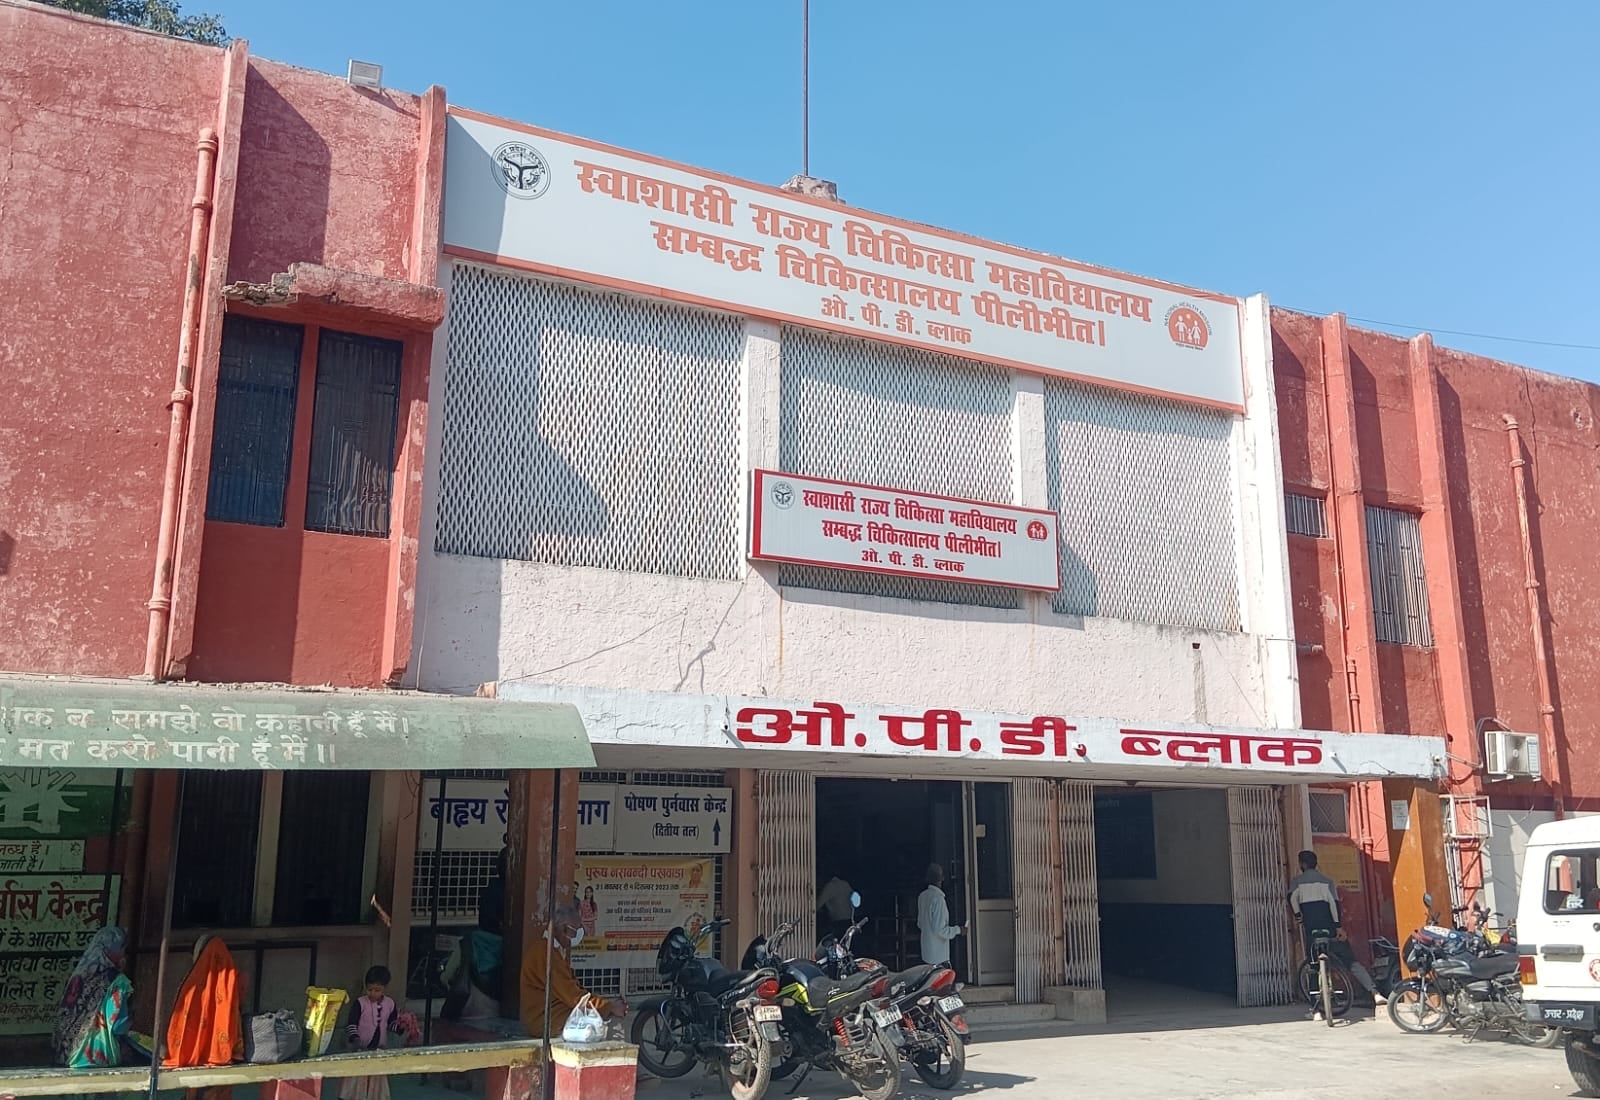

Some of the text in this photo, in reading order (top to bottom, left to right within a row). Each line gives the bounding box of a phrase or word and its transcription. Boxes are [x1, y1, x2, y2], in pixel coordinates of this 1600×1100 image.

[574, 160, 1152, 322] स्वाशासी राज्य चिकित्सा महाविद्यालय
[650, 221, 764, 272] सम्बद्ध
[775, 244, 962, 316] चिकित्सालय
[926, 320, 972, 344] ब्लाक
[803, 489, 856, 512] स्वाशासी
[860, 498, 890, 517] राज्य
[894, 498, 944, 524] चिकित्सा
[948, 509, 1017, 534] महाविद्यालय
[822, 520, 863, 542] सम्बद्ध
[867, 521, 940, 550] चिकित्सालय
[933, 559, 965, 572] ब्लाक
[18, 738, 74, 761] मत
[166, 736, 240, 763] पानी
[1120, 728, 1322, 766] ब्लाक
[624, 792, 657, 811] पोषण
[703, 794, 727, 813] केन्द्र
[8, 927, 25, 946] के
[28, 931, 71, 949] आहार
